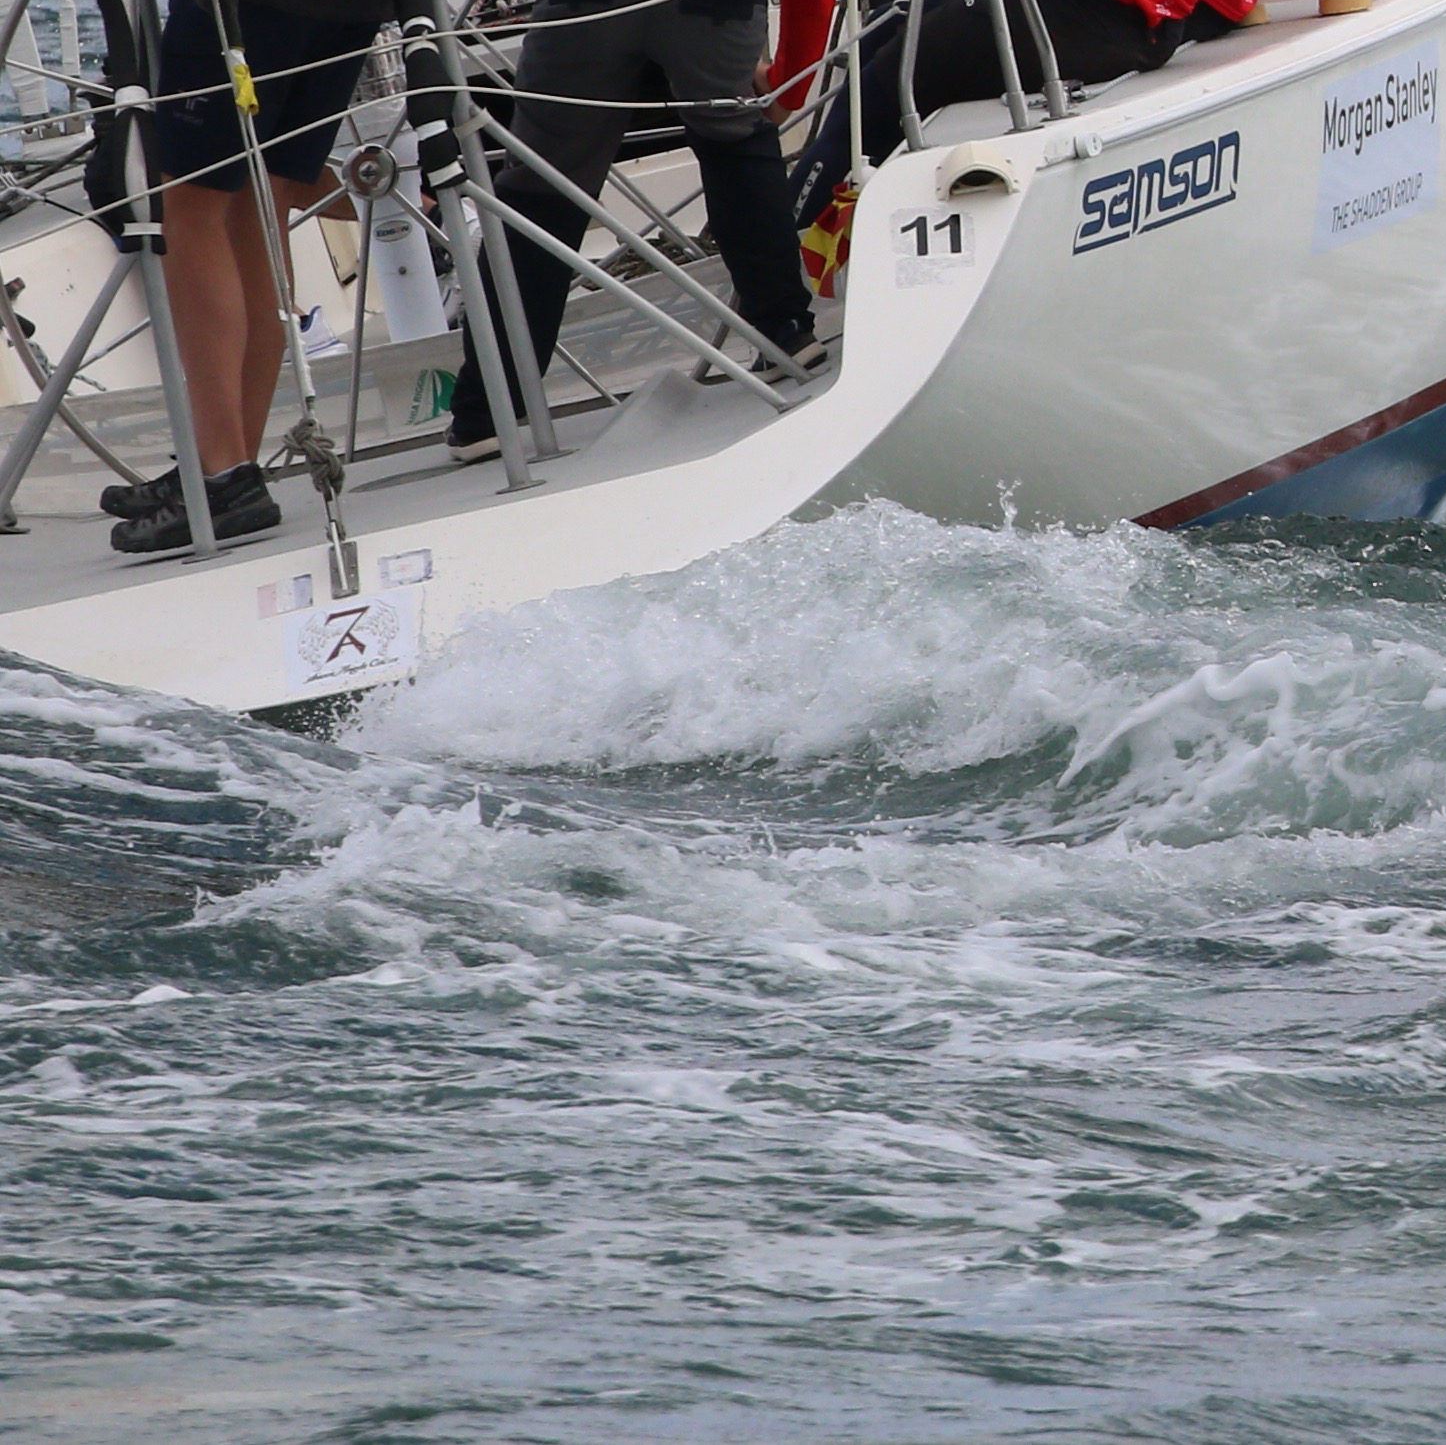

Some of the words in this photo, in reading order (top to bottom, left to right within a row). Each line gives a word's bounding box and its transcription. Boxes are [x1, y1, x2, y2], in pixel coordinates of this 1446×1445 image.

[1323, 96, 1383, 156] Morgan
[1385, 61, 1438, 129] Stanley
[1078, 130, 1241, 240] samson
[901, 214, 962, 256] 11
